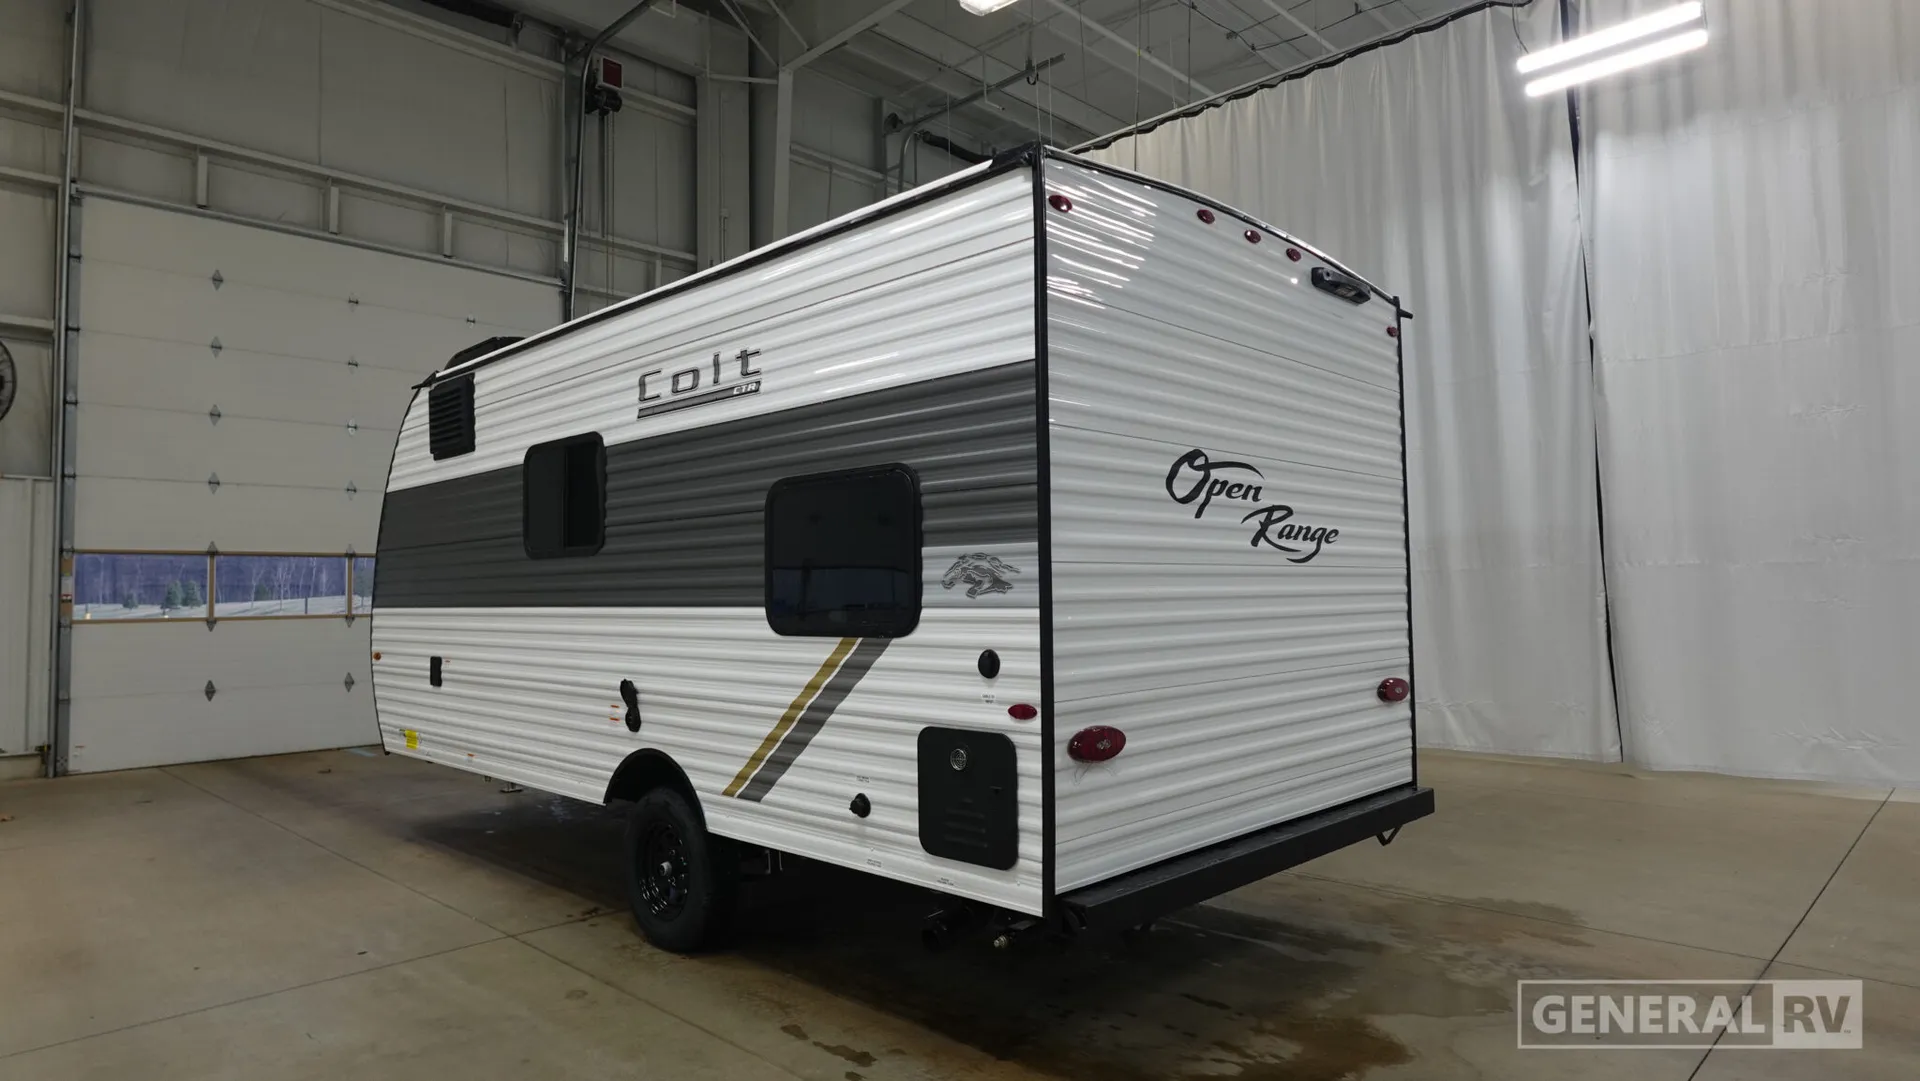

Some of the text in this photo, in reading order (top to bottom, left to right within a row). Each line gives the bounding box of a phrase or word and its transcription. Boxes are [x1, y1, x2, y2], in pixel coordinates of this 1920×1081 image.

[732, 383, 758, 396] CTR
[1165, 448, 1265, 519] Open
[1240, 504, 1340, 564] Range
